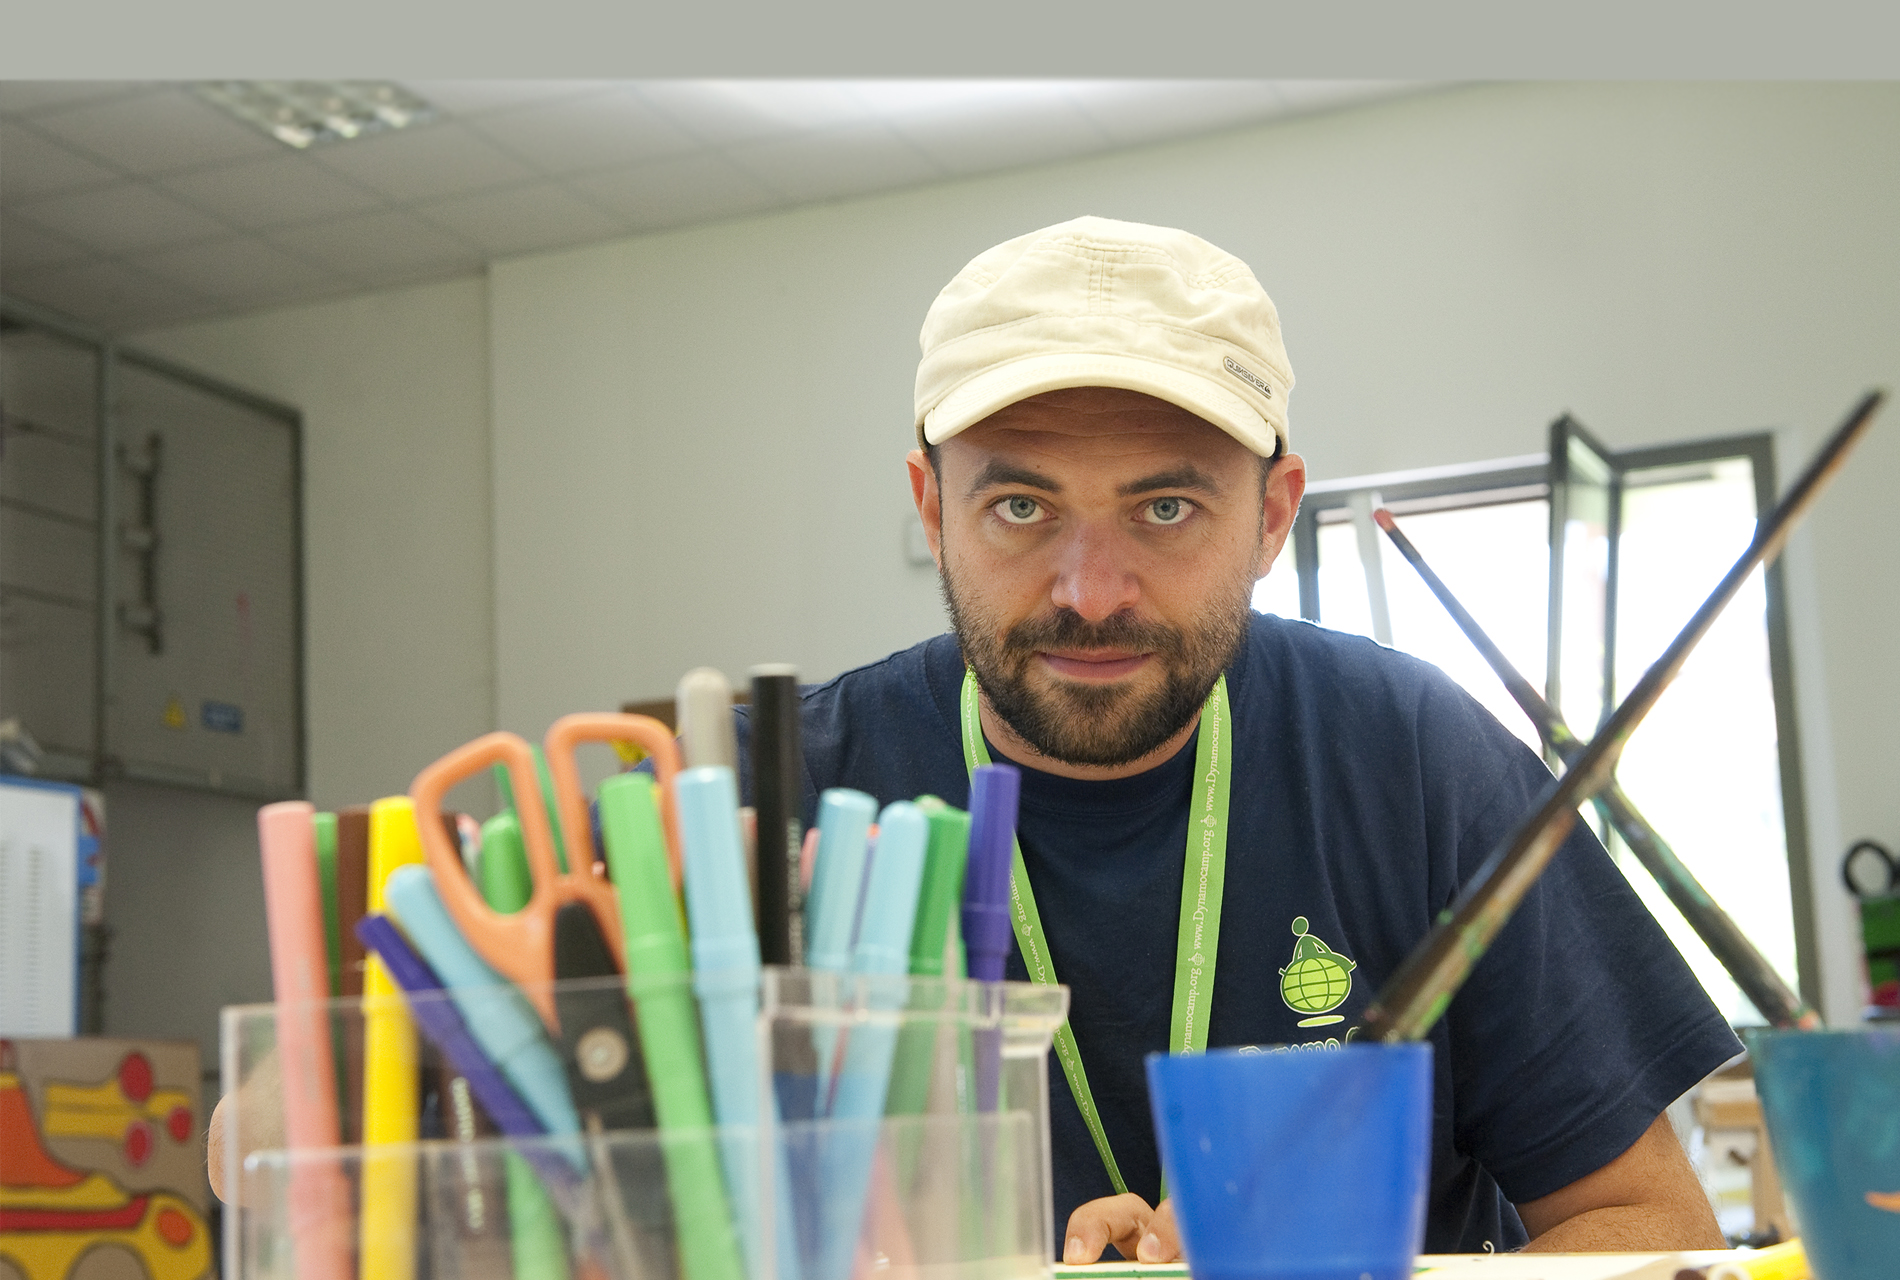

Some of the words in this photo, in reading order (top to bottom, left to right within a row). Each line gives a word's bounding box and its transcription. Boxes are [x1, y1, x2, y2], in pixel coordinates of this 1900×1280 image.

[1226, 358, 1264, 390] QUIKSILVER
[1205, 693, 1222, 812] www.Dynamocamp.org
[1192, 828, 1215, 951] www.Dynamocamp.org
